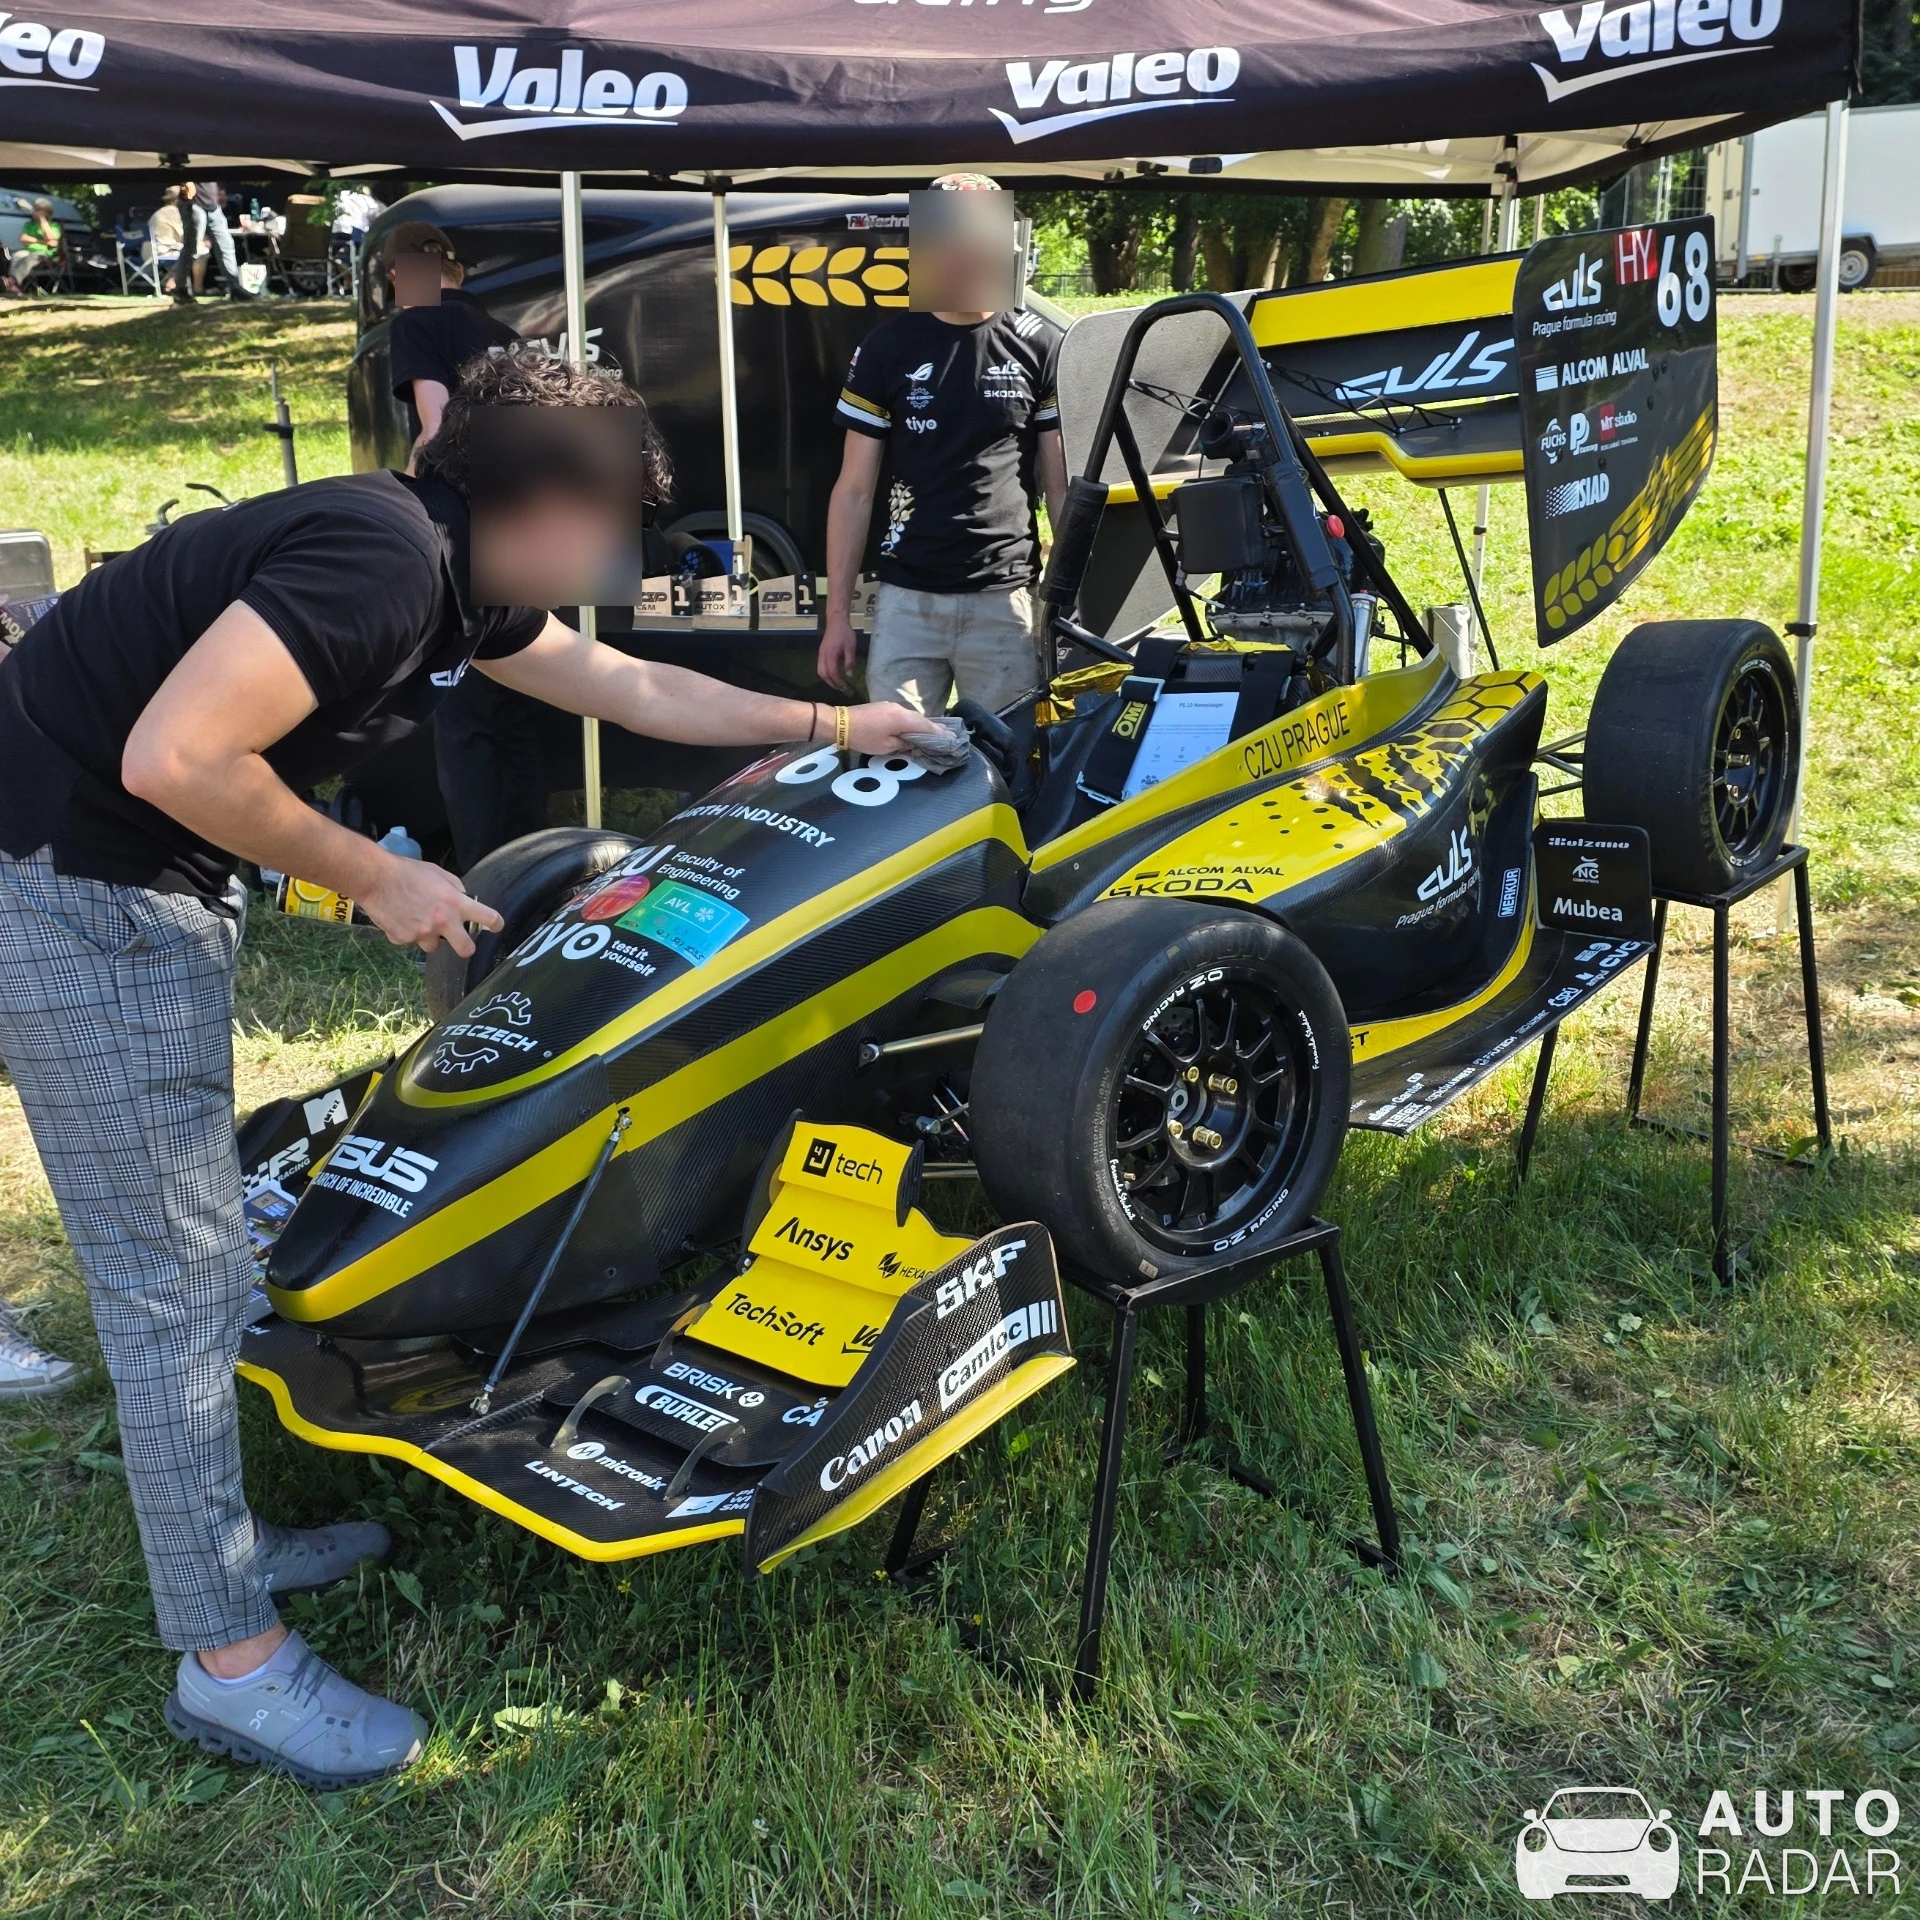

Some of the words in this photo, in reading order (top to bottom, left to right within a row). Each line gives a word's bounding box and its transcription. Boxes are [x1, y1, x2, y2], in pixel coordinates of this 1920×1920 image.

[1538, 0, 1783, 62] Valeo
[453, 45, 688, 118] Valeo
[1005, 46, 1241, 109] Valeo
[1619, 229, 1653, 284] HY
[1657, 231, 1711, 328] 68
[1532, 320, 1562, 338] Prague
[1562, 312, 1593, 331] formula
[1593, 309, 1618, 326] racing
[1562, 355, 1609, 387] ALCOM
[1612, 347, 1650, 376] ALVAL
[905, 416, 937, 434] tiyo
[1541, 432, 1567, 451] FUCHS
[1580, 473, 1610, 509] SIAD
[674, 585, 690, 607] 1
[731, 584, 746, 605] 1
[761, 603, 778, 611] EFF
[798, 584, 814, 605] 1
[1244, 734, 1283, 780] CZU
[1281, 701, 1351, 763] PRAGUE
[775, 743, 928, 807] 68
[731, 804, 836, 848] INDUSTRY
[656, 862, 741, 901] Engineering
[671, 850, 724, 873] Faculty
[723, 865, 746, 879] of
[1163, 866, 1225, 877] ALCOM
[1231, 865, 1285, 876] ALVAL
[1577, 868, 1600, 880] NC
[664, 896, 692, 914] AVL
[1395, 903, 1435, 929] Prague
[1434, 882, 1468, 911] formula
[1500, 868, 1519, 917] MERKUR
[1553, 896, 1623, 922] Mubea
[599, 948, 657, 978] yourself
[611, 938, 637, 956] test
[636, 947, 649, 961] it
[1142, 986, 1185, 1031] RACING
[277, 1157, 311, 1182] RACING
[835, 1153, 883, 1185] tech
[335, 1176, 353, 1192] OF
[346, 1179, 414, 1218] INCREDIBLE
[1250, 1188, 1289, 1233] RACING
[774, 1216, 855, 1262] Ansys
[935, 1239, 1027, 1320] SKF
[725, 1292, 825, 1347] TechSoft
[943, 1321, 1023, 1398] Camloc
[662, 1361, 745, 1400] BRISK
[819, 1399, 923, 1492] Canon
[524, 1459, 626, 1512] LINTECH
[595, 1455, 669, 1491] micronix
